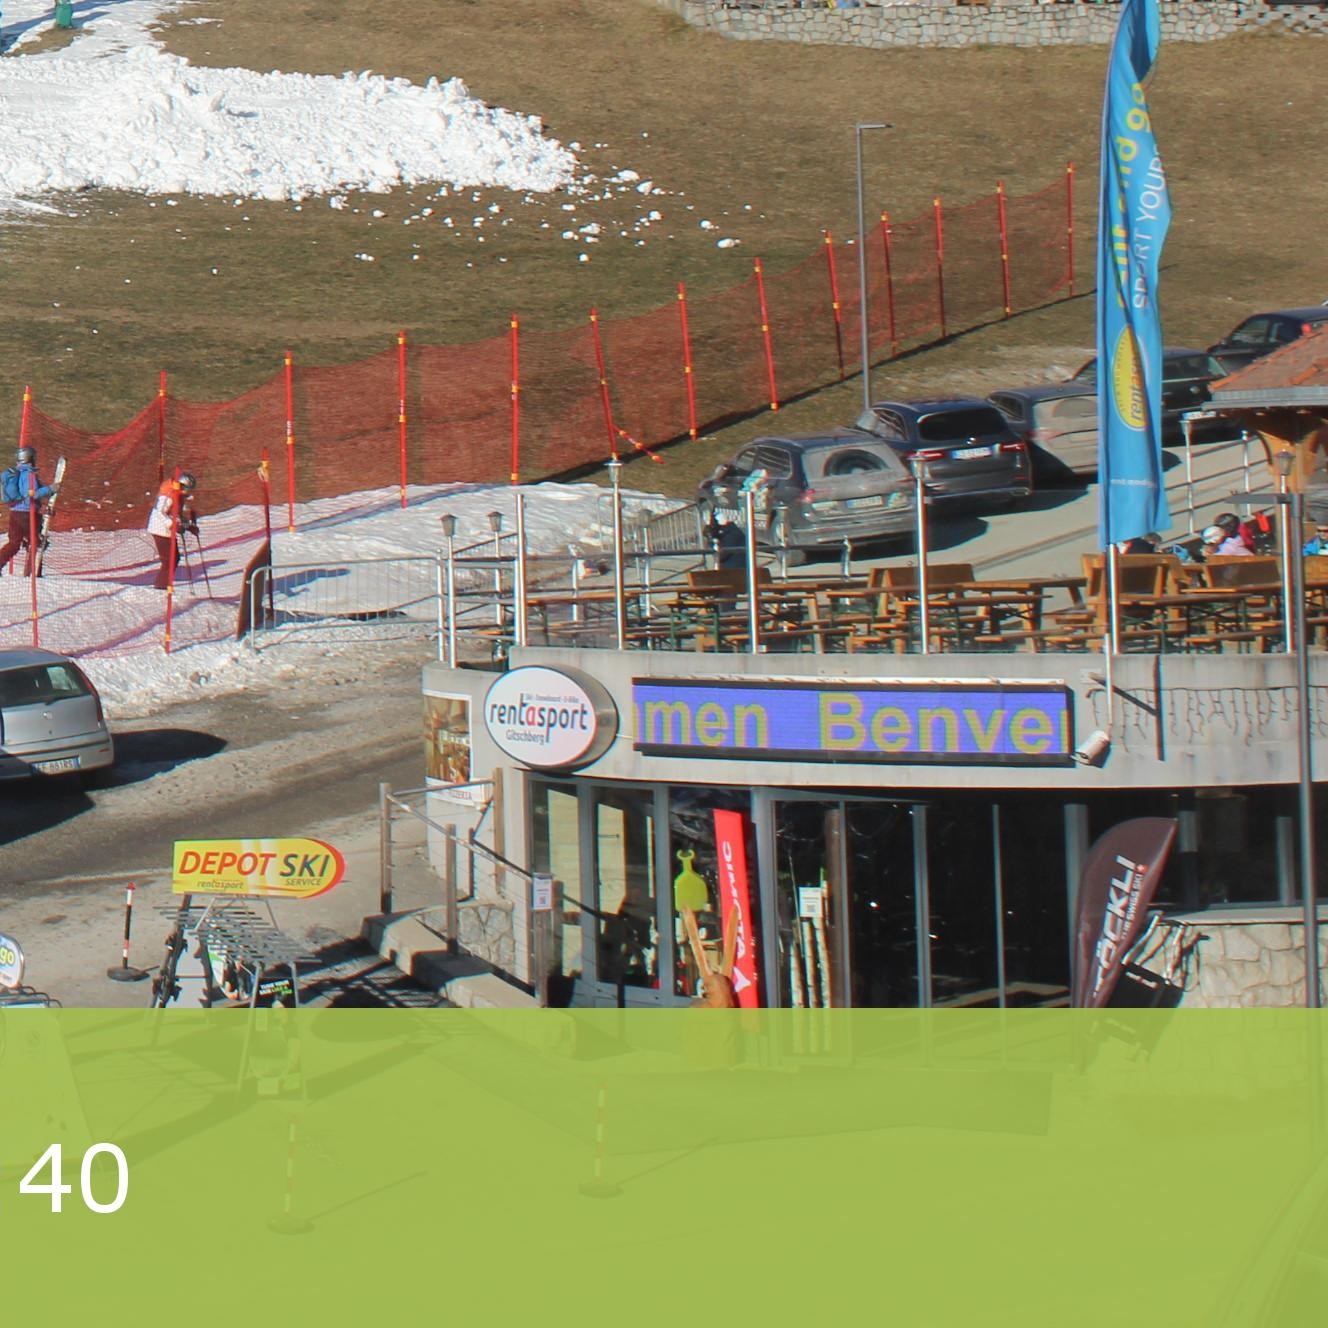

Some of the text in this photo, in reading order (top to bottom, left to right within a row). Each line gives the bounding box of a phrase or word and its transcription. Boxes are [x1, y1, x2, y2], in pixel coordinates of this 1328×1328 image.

[489, 693, 589, 743] rentasport
[505, 728, 545, 746] Gitschberg
[179, 851, 329, 878] DEPOT SKI
[285, 878, 321, 887] SERVICE
[0, 946, 16, 967] go
